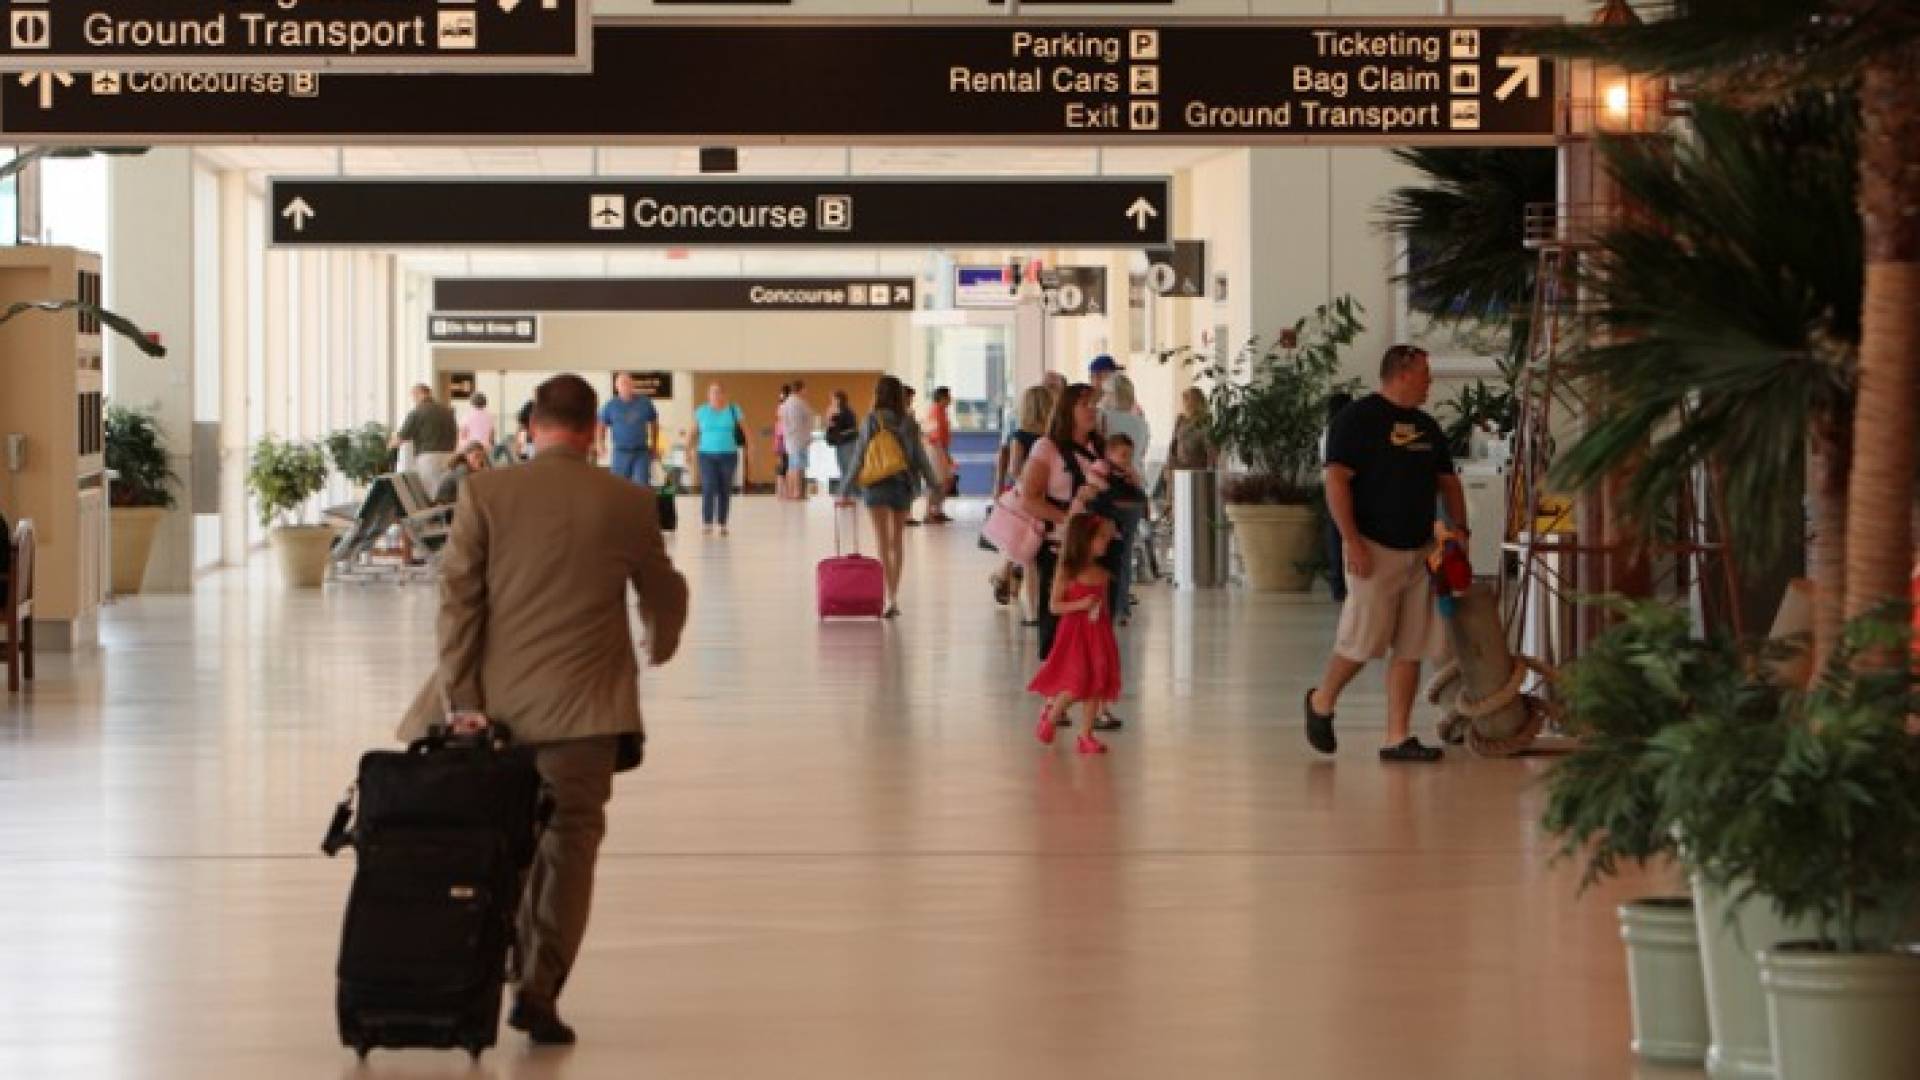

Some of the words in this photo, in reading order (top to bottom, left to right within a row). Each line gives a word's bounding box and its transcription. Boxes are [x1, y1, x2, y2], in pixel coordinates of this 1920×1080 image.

[84, 13, 225, 47] Ground
[239, 13, 425, 53] Transport
[1012, 31, 1120, 61] Parking
[1313, 31, 1440, 61] Ticketing
[127, 73, 285, 93] Concourse
[950, 66, 1041, 93] Rental
[1052, 66, 1119, 93] Cars
[1293, 66, 1349, 96] Bag
[1358, 66, 1440, 92] Claim
[1066, 102, 1119, 128] Exit
[1185, 102, 1290, 128] Ground
[1302, 102, 1440, 131] Transport
[634, 198, 808, 228] Concourse
[750, 285, 846, 304] Concourse
